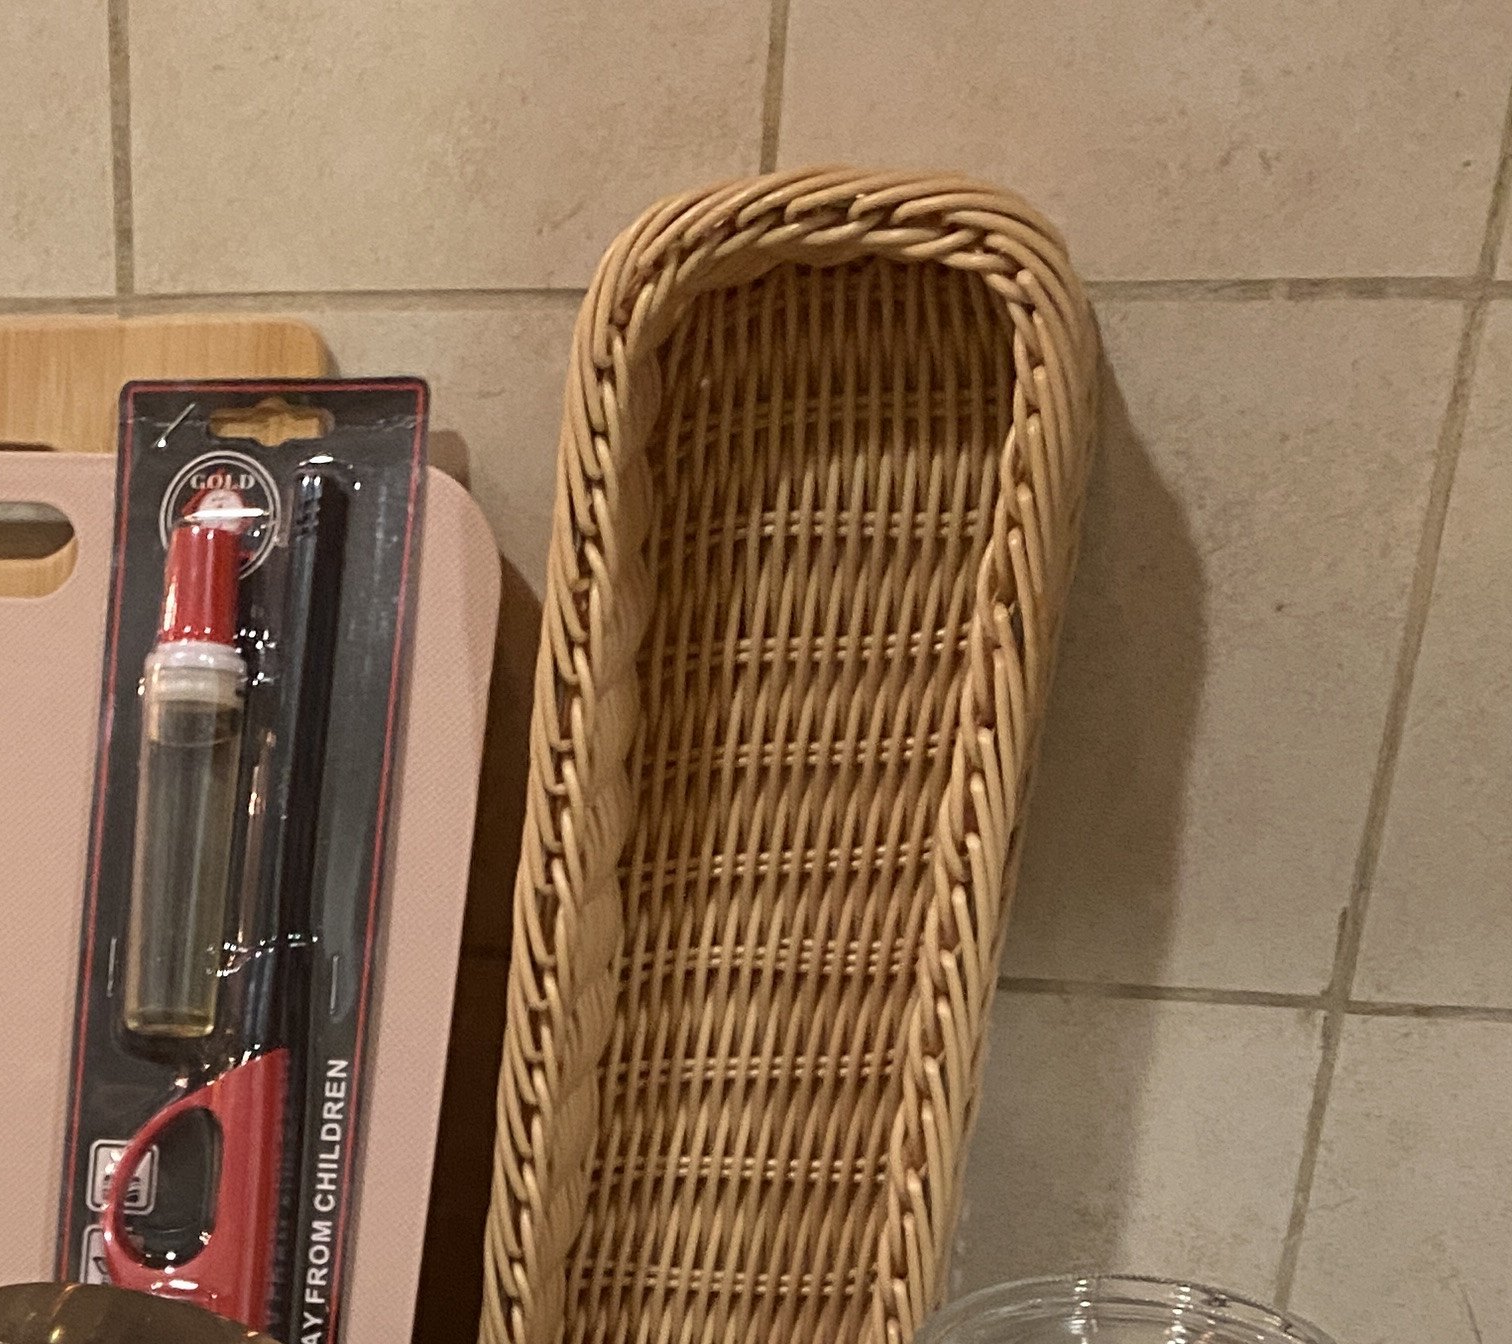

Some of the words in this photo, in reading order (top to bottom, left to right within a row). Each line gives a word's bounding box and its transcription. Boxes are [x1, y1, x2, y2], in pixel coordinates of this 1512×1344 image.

[190, 472, 255, 491] GOLD
[313, 1059, 350, 1214] CHILDREN
[305, 1220, 334, 1305] FROM
